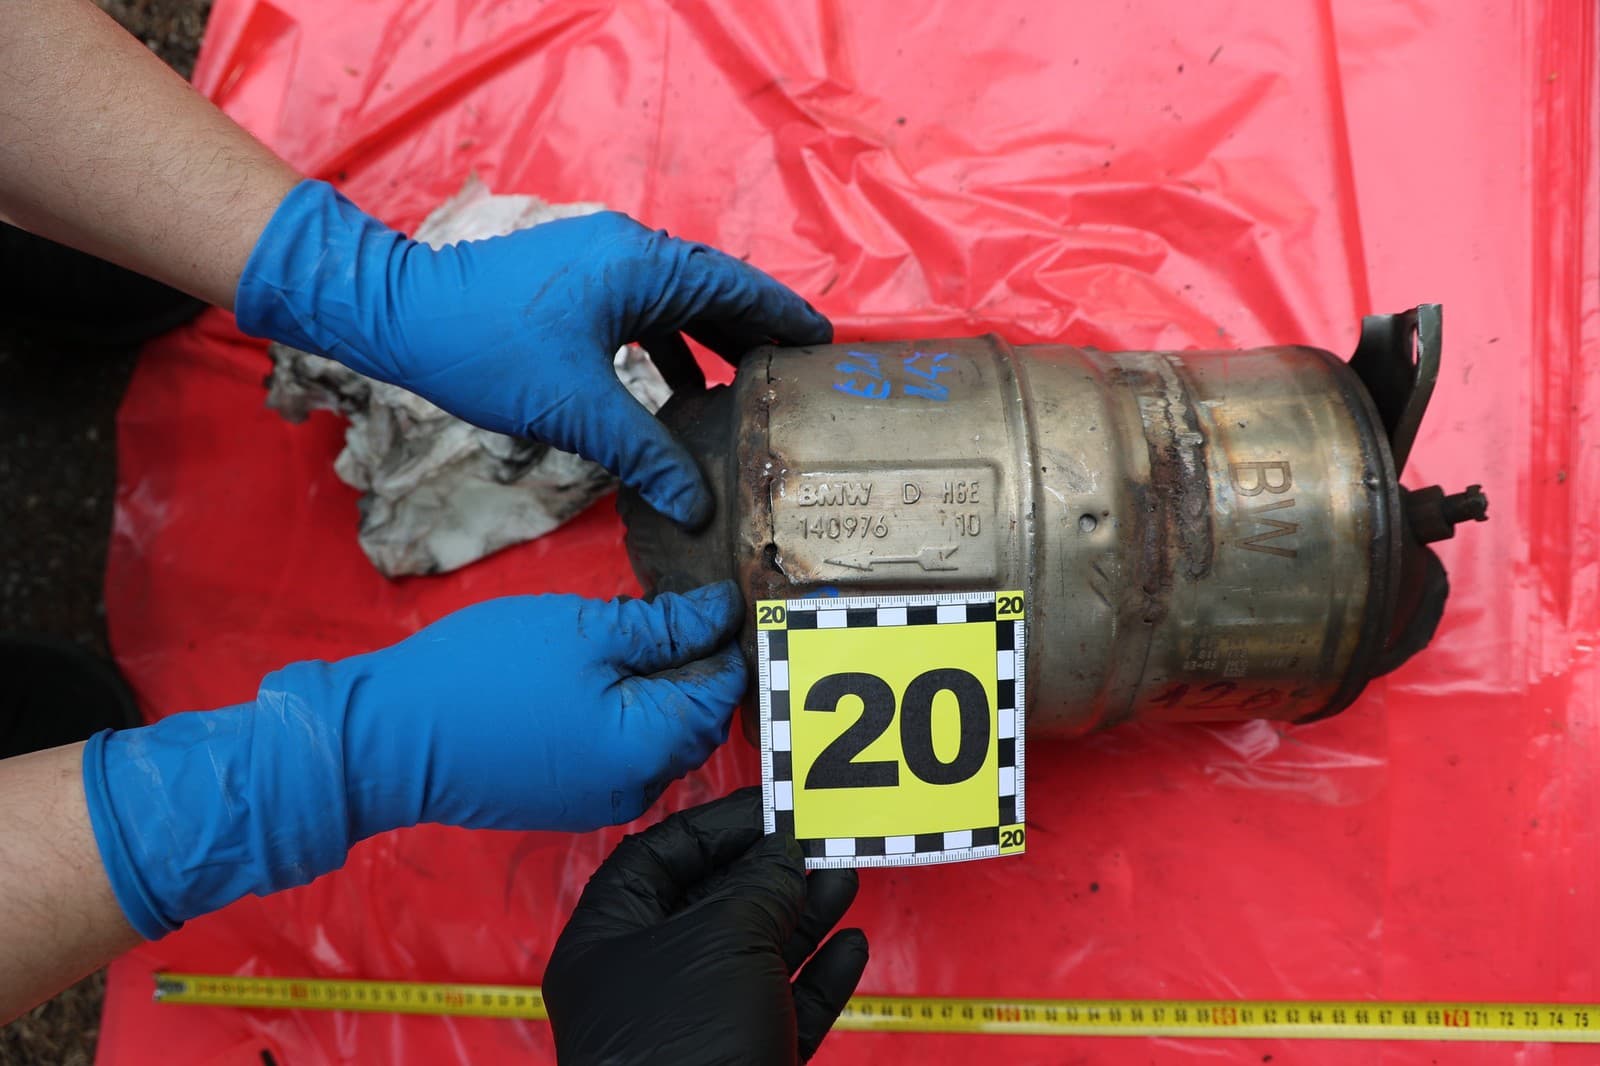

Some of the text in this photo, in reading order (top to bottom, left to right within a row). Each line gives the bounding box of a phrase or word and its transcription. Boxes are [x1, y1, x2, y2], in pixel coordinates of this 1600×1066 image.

[799, 482, 872, 506] BMW
[902, 482, 922, 505] D
[1229, 460, 1299, 559] BW
[799, 514, 889, 539] 140976
[758, 605, 785, 624] 20
[997, 596, 1024, 615] 20
[803, 667, 991, 790] 20
[1000, 829, 1025, 848] 20
[1475, 1010, 1488, 1026] 71
[1499, 1011, 1514, 1026] 72
[1524, 1011, 1539, 1026] 73
[1549, 1011, 1564, 1026] 74
[1574, 1012, 1588, 1027] 75
